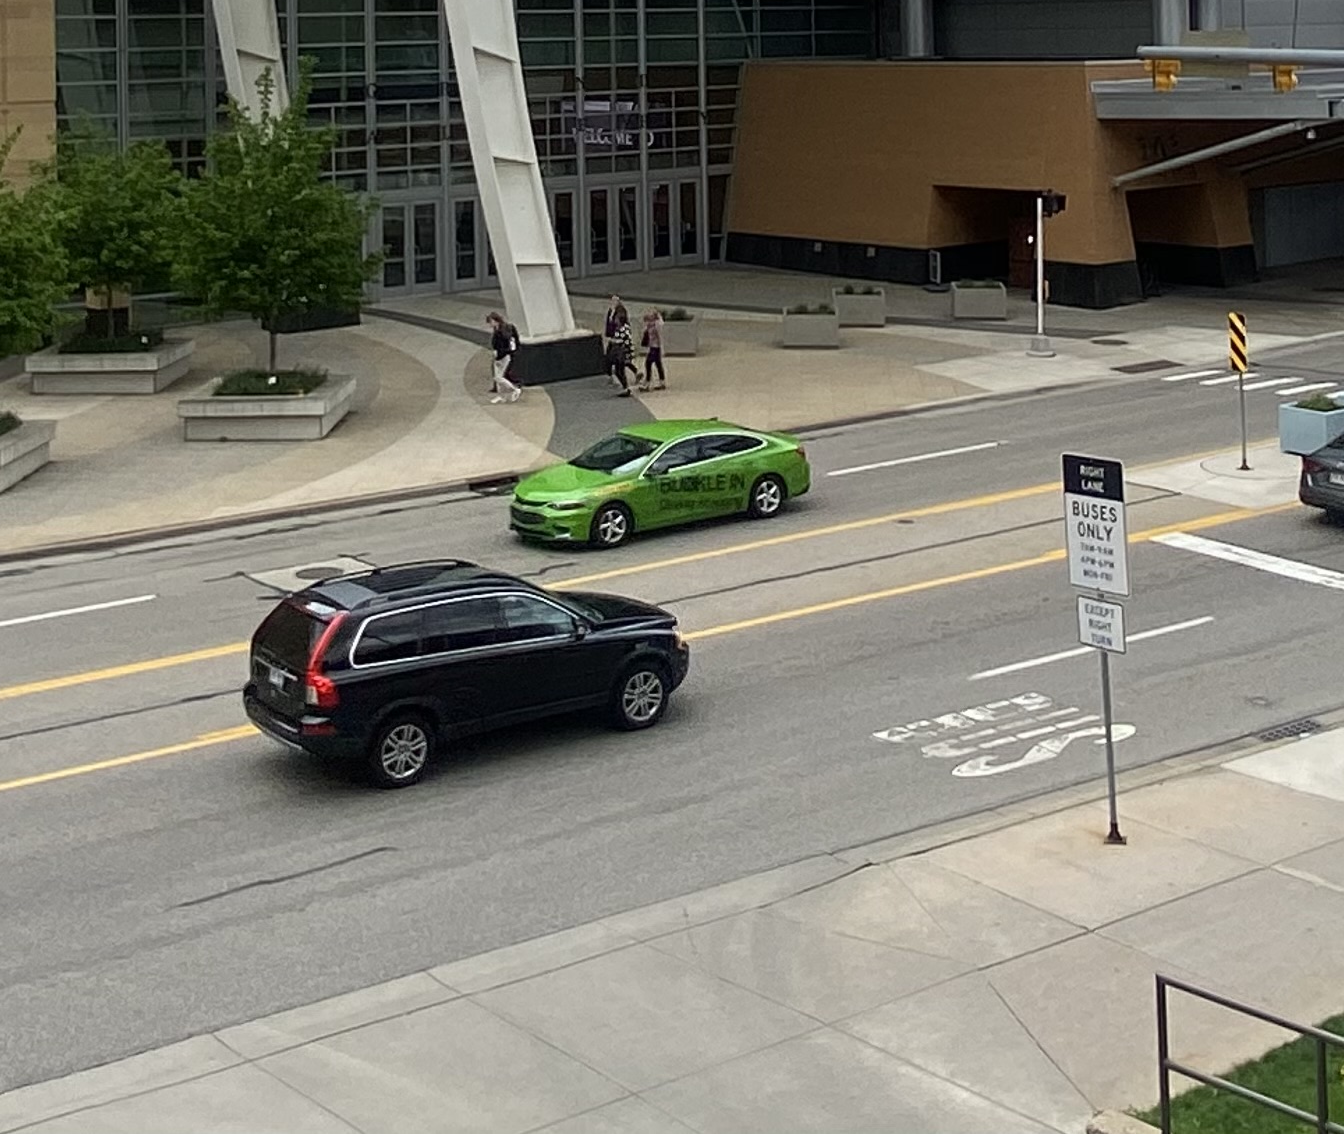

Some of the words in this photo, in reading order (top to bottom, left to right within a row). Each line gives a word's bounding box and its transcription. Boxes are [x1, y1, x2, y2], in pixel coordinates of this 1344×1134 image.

[1079, 465, 1105, 479] RIGHT
[1081, 479, 1105, 493] LANE
[1072, 500, 1117, 523] BUSES
[1077, 521, 1114, 542] ONLY
[1089, 618, 1112, 633] RIGHT
[1091, 633, 1113, 647] TURN
